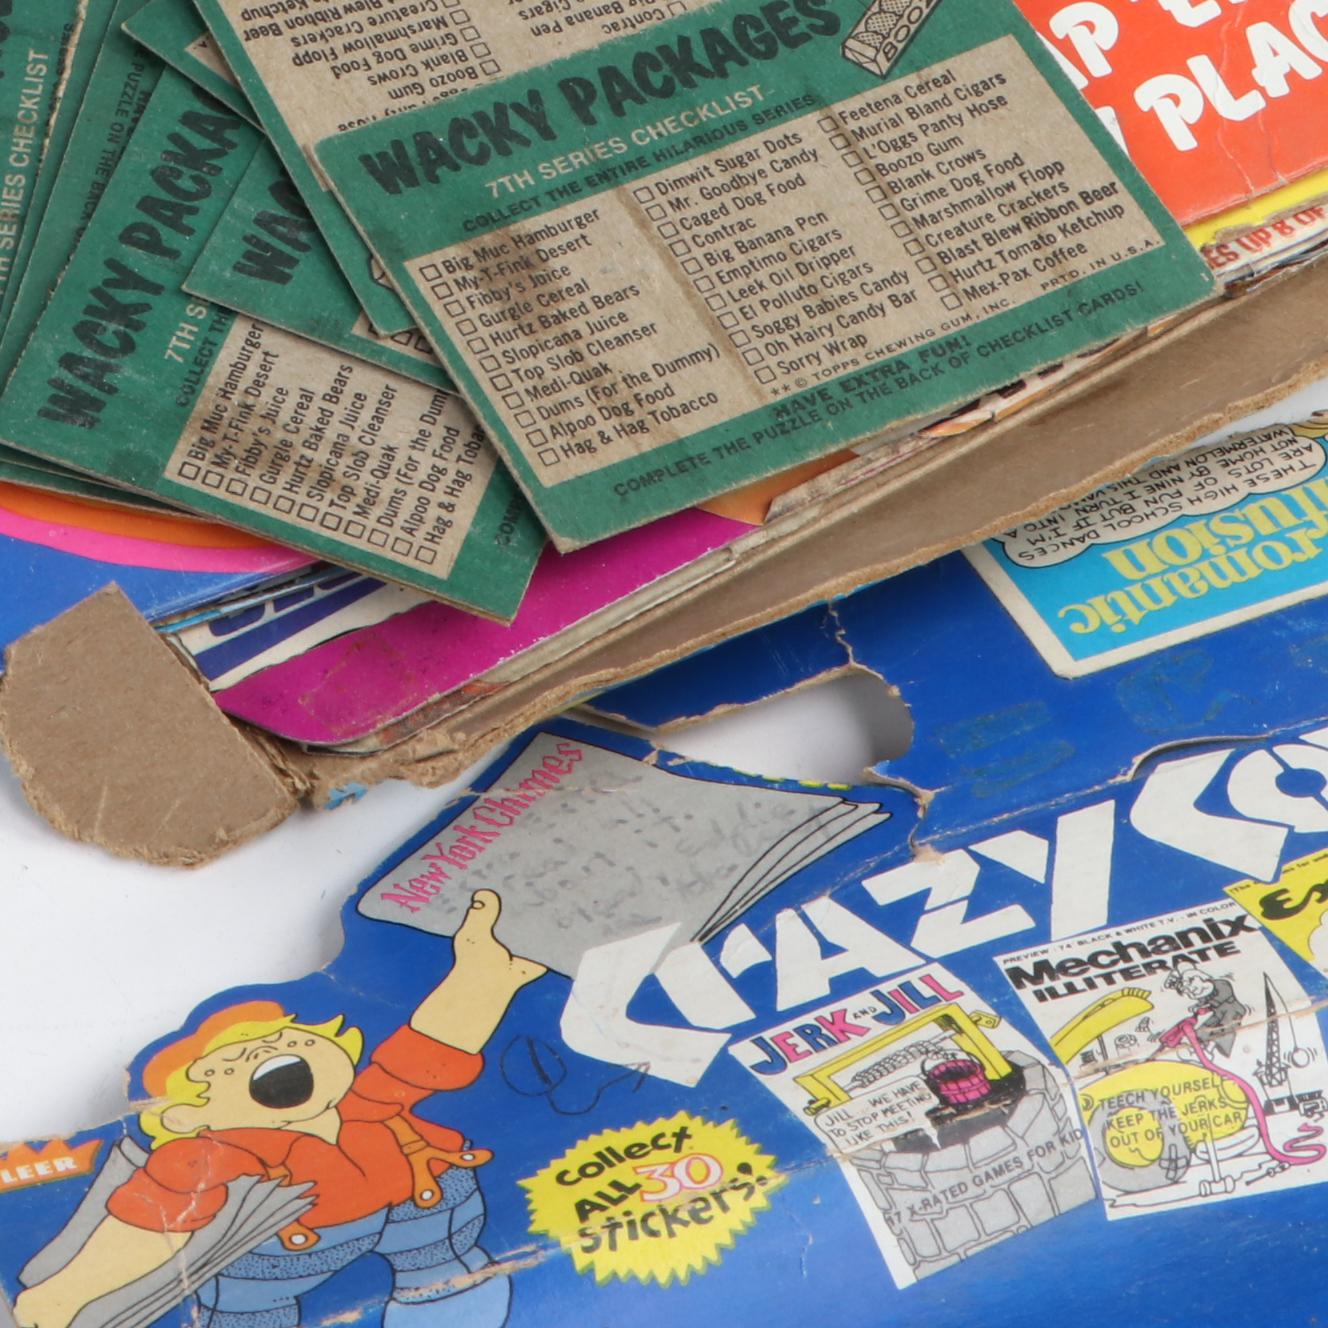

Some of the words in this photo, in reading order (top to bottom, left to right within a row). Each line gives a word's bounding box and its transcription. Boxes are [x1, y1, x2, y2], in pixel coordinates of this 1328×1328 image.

[9, 47, 51, 168] CHECKLIST
[850, 112, 905, 143] Murial
[904, 92, 954, 121] Bland
[953, 73, 1007, 102] Cigars
[357, 88, 558, 196] WACKY
[484, 169, 536, 198] 7TH
[537, 137, 628, 180] SERIES
[631, 84, 764, 146] CHECKLIST
[885, 168, 936, 195] Blank
[935, 148, 987, 176] Crows
[666, 196, 699, 213] Mr.
[699, 168, 768, 201] Goodbye
[769, 148, 819, 174] Candy
[911, 180, 1017, 230] Marshmallow
[1017, 160, 1065, 186] Flopp
[714, 251, 788, 286] Emptimo
[788, 228, 843, 257] Cigars
[726, 278, 768, 303] Leek
[768, 267, 795, 287] Oil
[794, 245, 856, 277] Dripper
[961, 267, 1033, 302] Mex-Pax
[1032, 243, 1088, 273] Coffee
[488, 322, 537, 354] Hurtz
[537, 300, 591, 330] Baked
[590, 284, 641, 310] Bears
[510, 365, 545, 383] Top
[546, 348, 585, 372] Slob
[585, 322, 657, 357] Cleanser
[523, 361, 613, 402] Medi-Quak
[549, 414, 597, 440] Alpoo
[596, 401, 635, 421] Dog
[632, 382, 676, 409] Food
[1188, 483, 1240, 507] HIGH
[1243, 459, 1318, 489] THESE
[1017, 528, 1101, 562] DANCES
[1106, 501, 1184, 533] SCHOOL
[1057, 527, 1324, 635] romantic
[380, 860, 453, 913] New
[421, 823, 501, 871] York
[1004, 913, 1260, 991] Mechanix
[1032, 940, 1241, 1003] ILLITERATE
[749, 1007, 872, 1076] JERK
[869, 972, 965, 1026] JILL
[1105, 1111, 1144, 1131] KEEP
[1150, 1105, 1176, 1121] THE
[1181, 1097, 1228, 1116] JERKS
[1109, 1132, 1141, 1148] OUT
[1145, 1127, 1164, 1142] OF
[1169, 1119, 1209, 1137] YOUR
[1212, 1111, 1243, 1128] CAR
[574, 1179, 643, 1224] ALL
[631, 1152, 725, 1203] 30
[972, 1157, 1023, 1187] GAMES
[1027, 1141, 1058, 1160] FOR
